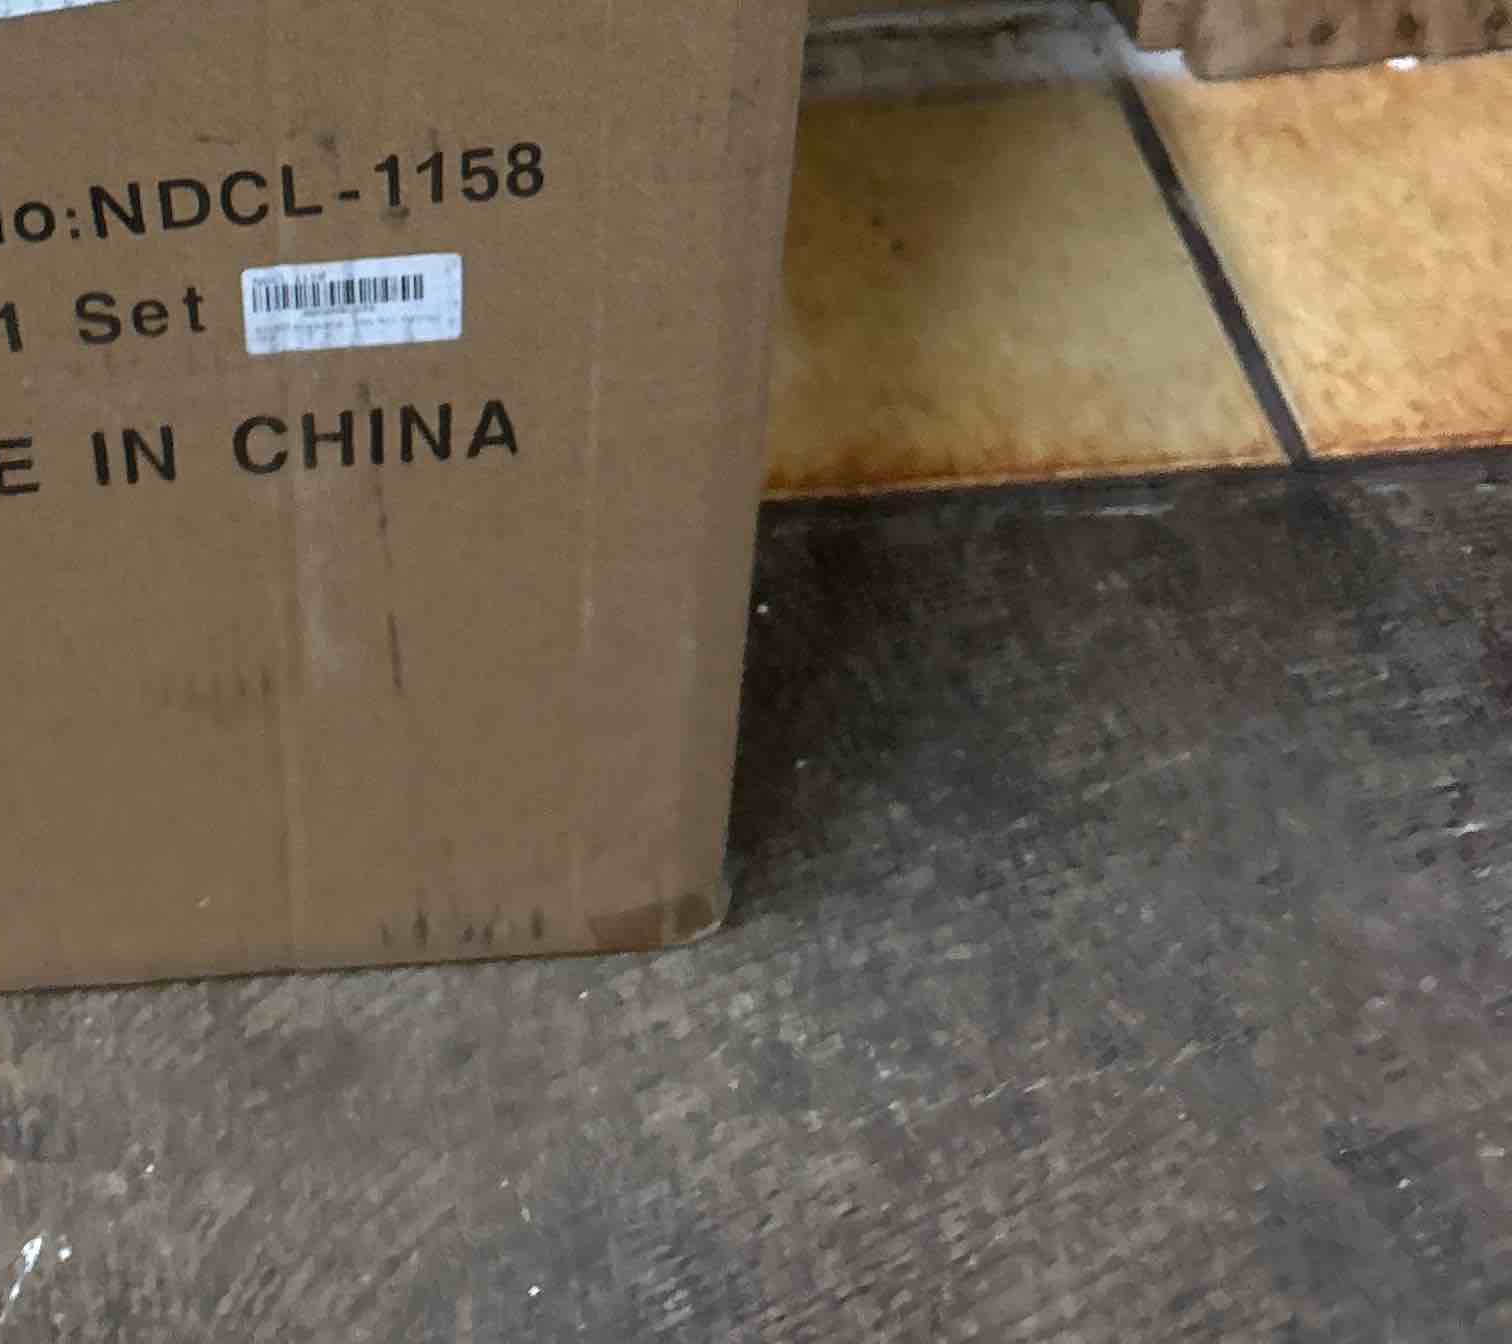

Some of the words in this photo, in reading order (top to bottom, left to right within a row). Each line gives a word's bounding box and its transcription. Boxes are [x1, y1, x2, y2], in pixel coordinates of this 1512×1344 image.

[75, 286, 205, 346] Set
[93, 424, 177, 487] IN
[233, 399, 520, 475] CHINA
